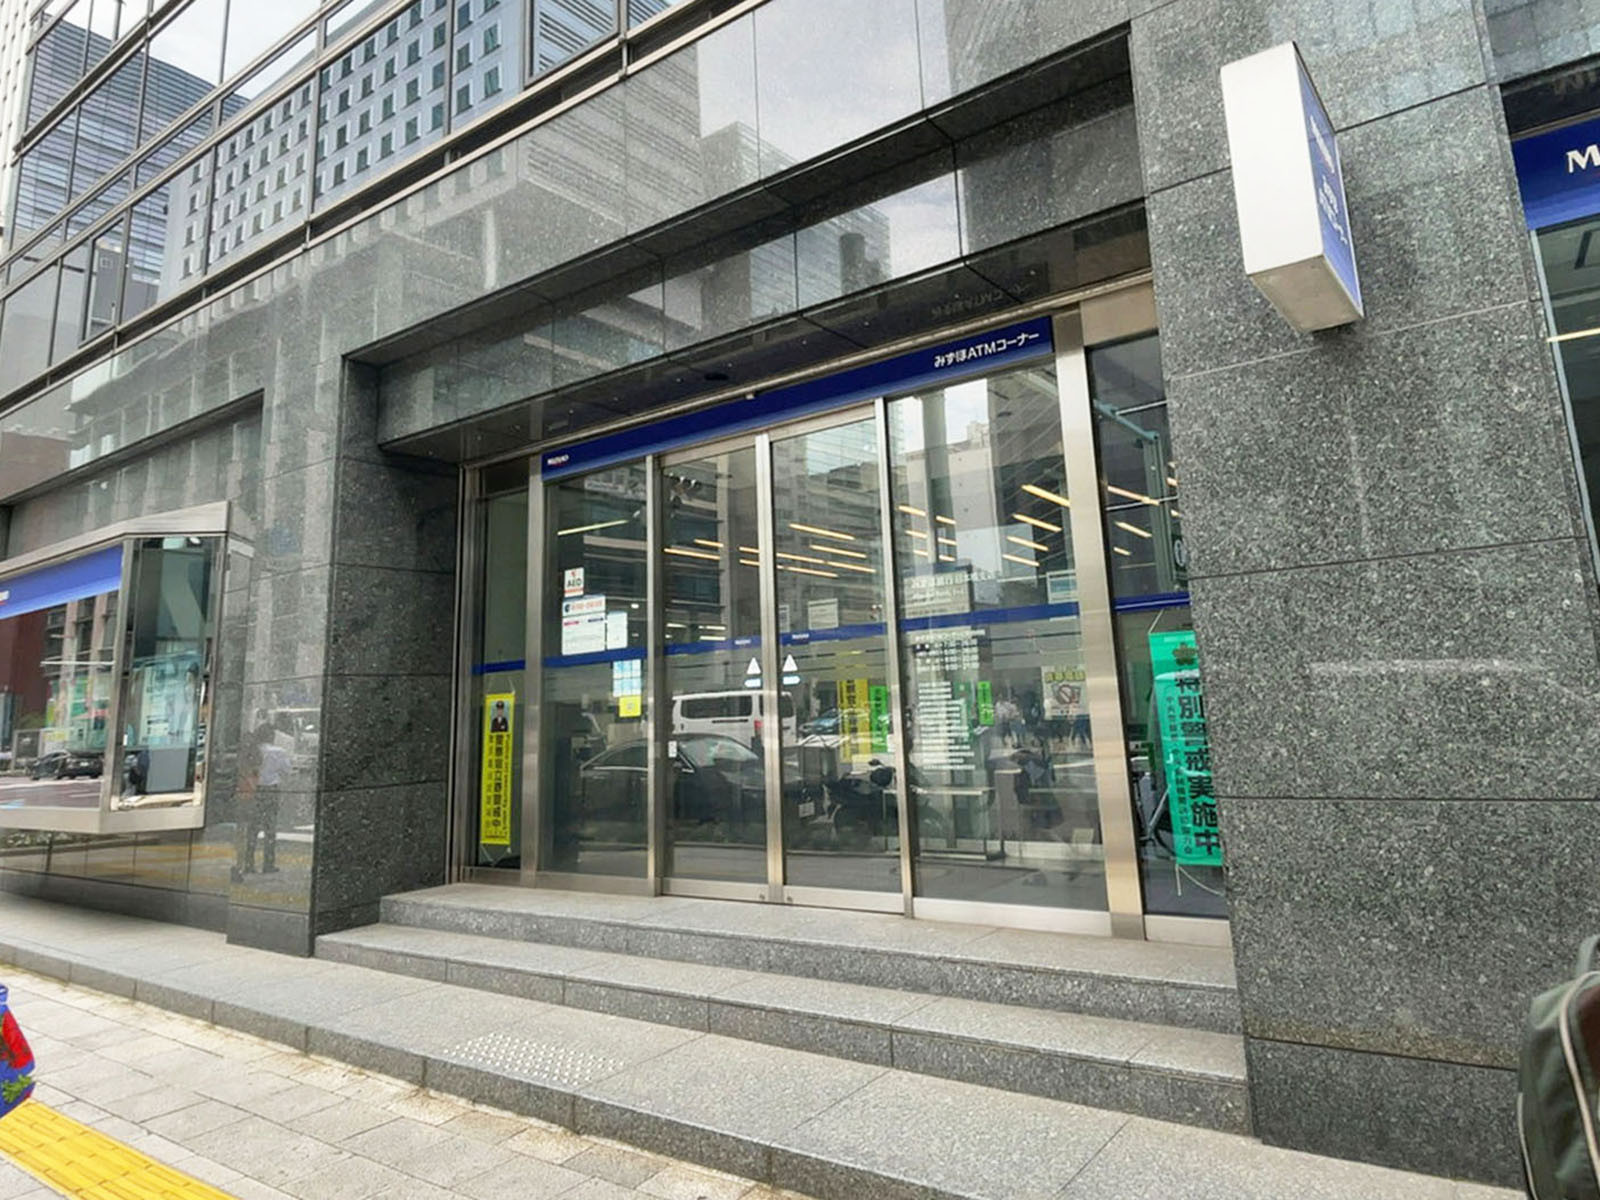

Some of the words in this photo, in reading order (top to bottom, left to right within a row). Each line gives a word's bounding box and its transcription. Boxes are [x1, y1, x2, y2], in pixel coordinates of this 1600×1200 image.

[934, 333, 1039, 367] みずほATMコーナー
[567, 578, 582, 587] AED
[1174, 669, 1221, 855] 特別警戒実施中
